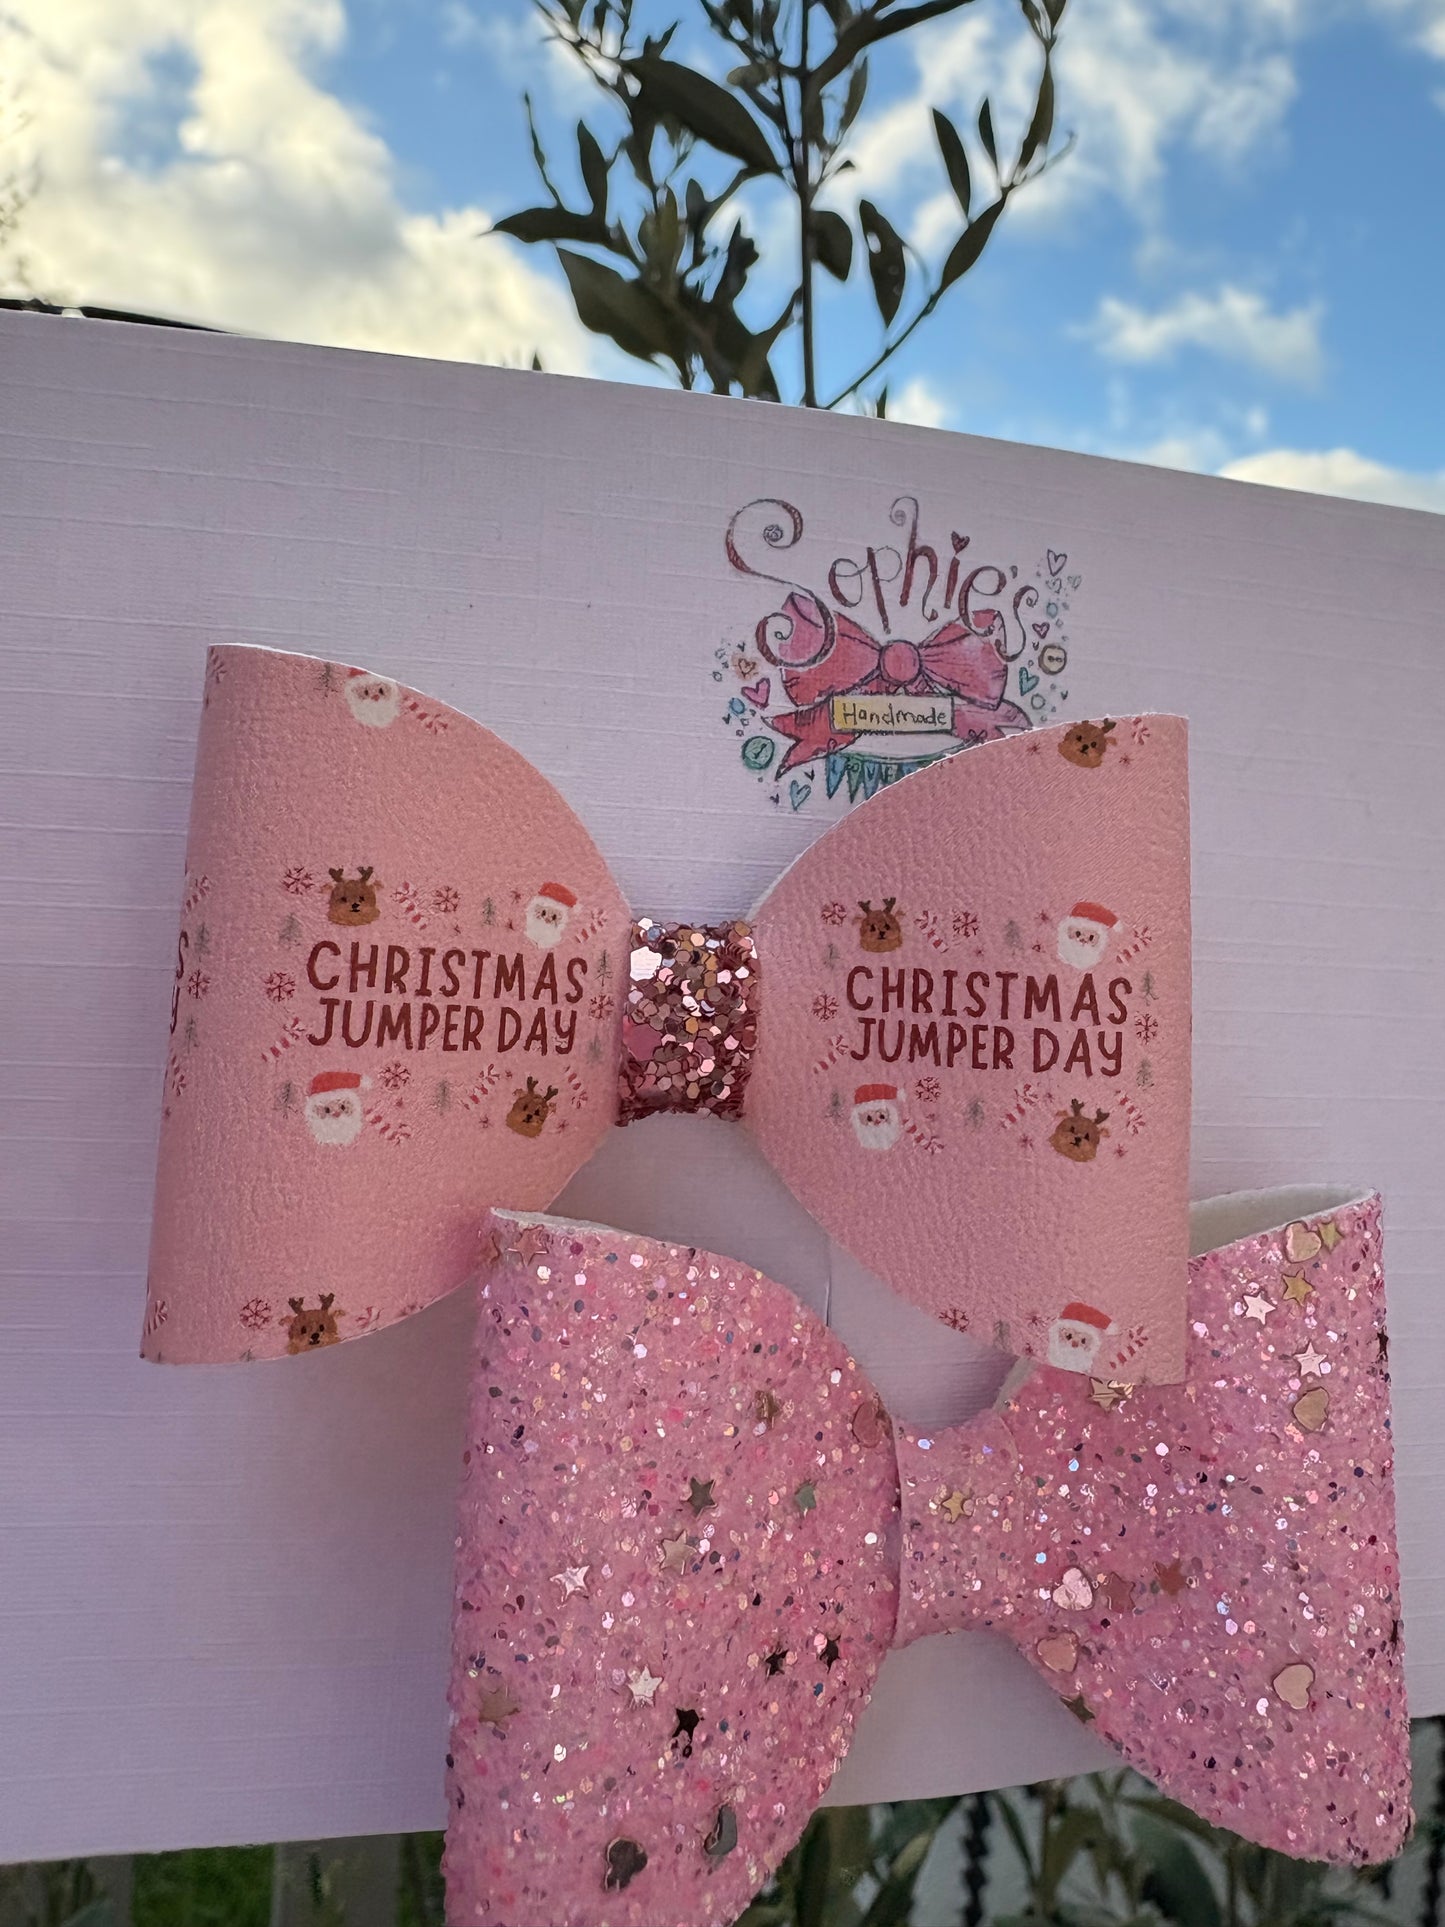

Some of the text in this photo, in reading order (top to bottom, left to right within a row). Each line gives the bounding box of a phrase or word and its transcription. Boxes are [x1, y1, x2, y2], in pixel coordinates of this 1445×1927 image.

[725, 496, 1040, 668] Sophie's
[842, 701, 948, 728] Handmade
[306, 940, 588, 1005] CHRISTMAS
[846, 965, 1133, 1026] CHRISTMAS
[307, 997, 578, 1056] JUMPER DAY
[850, 1016, 1123, 1078] JUMPER DAY
